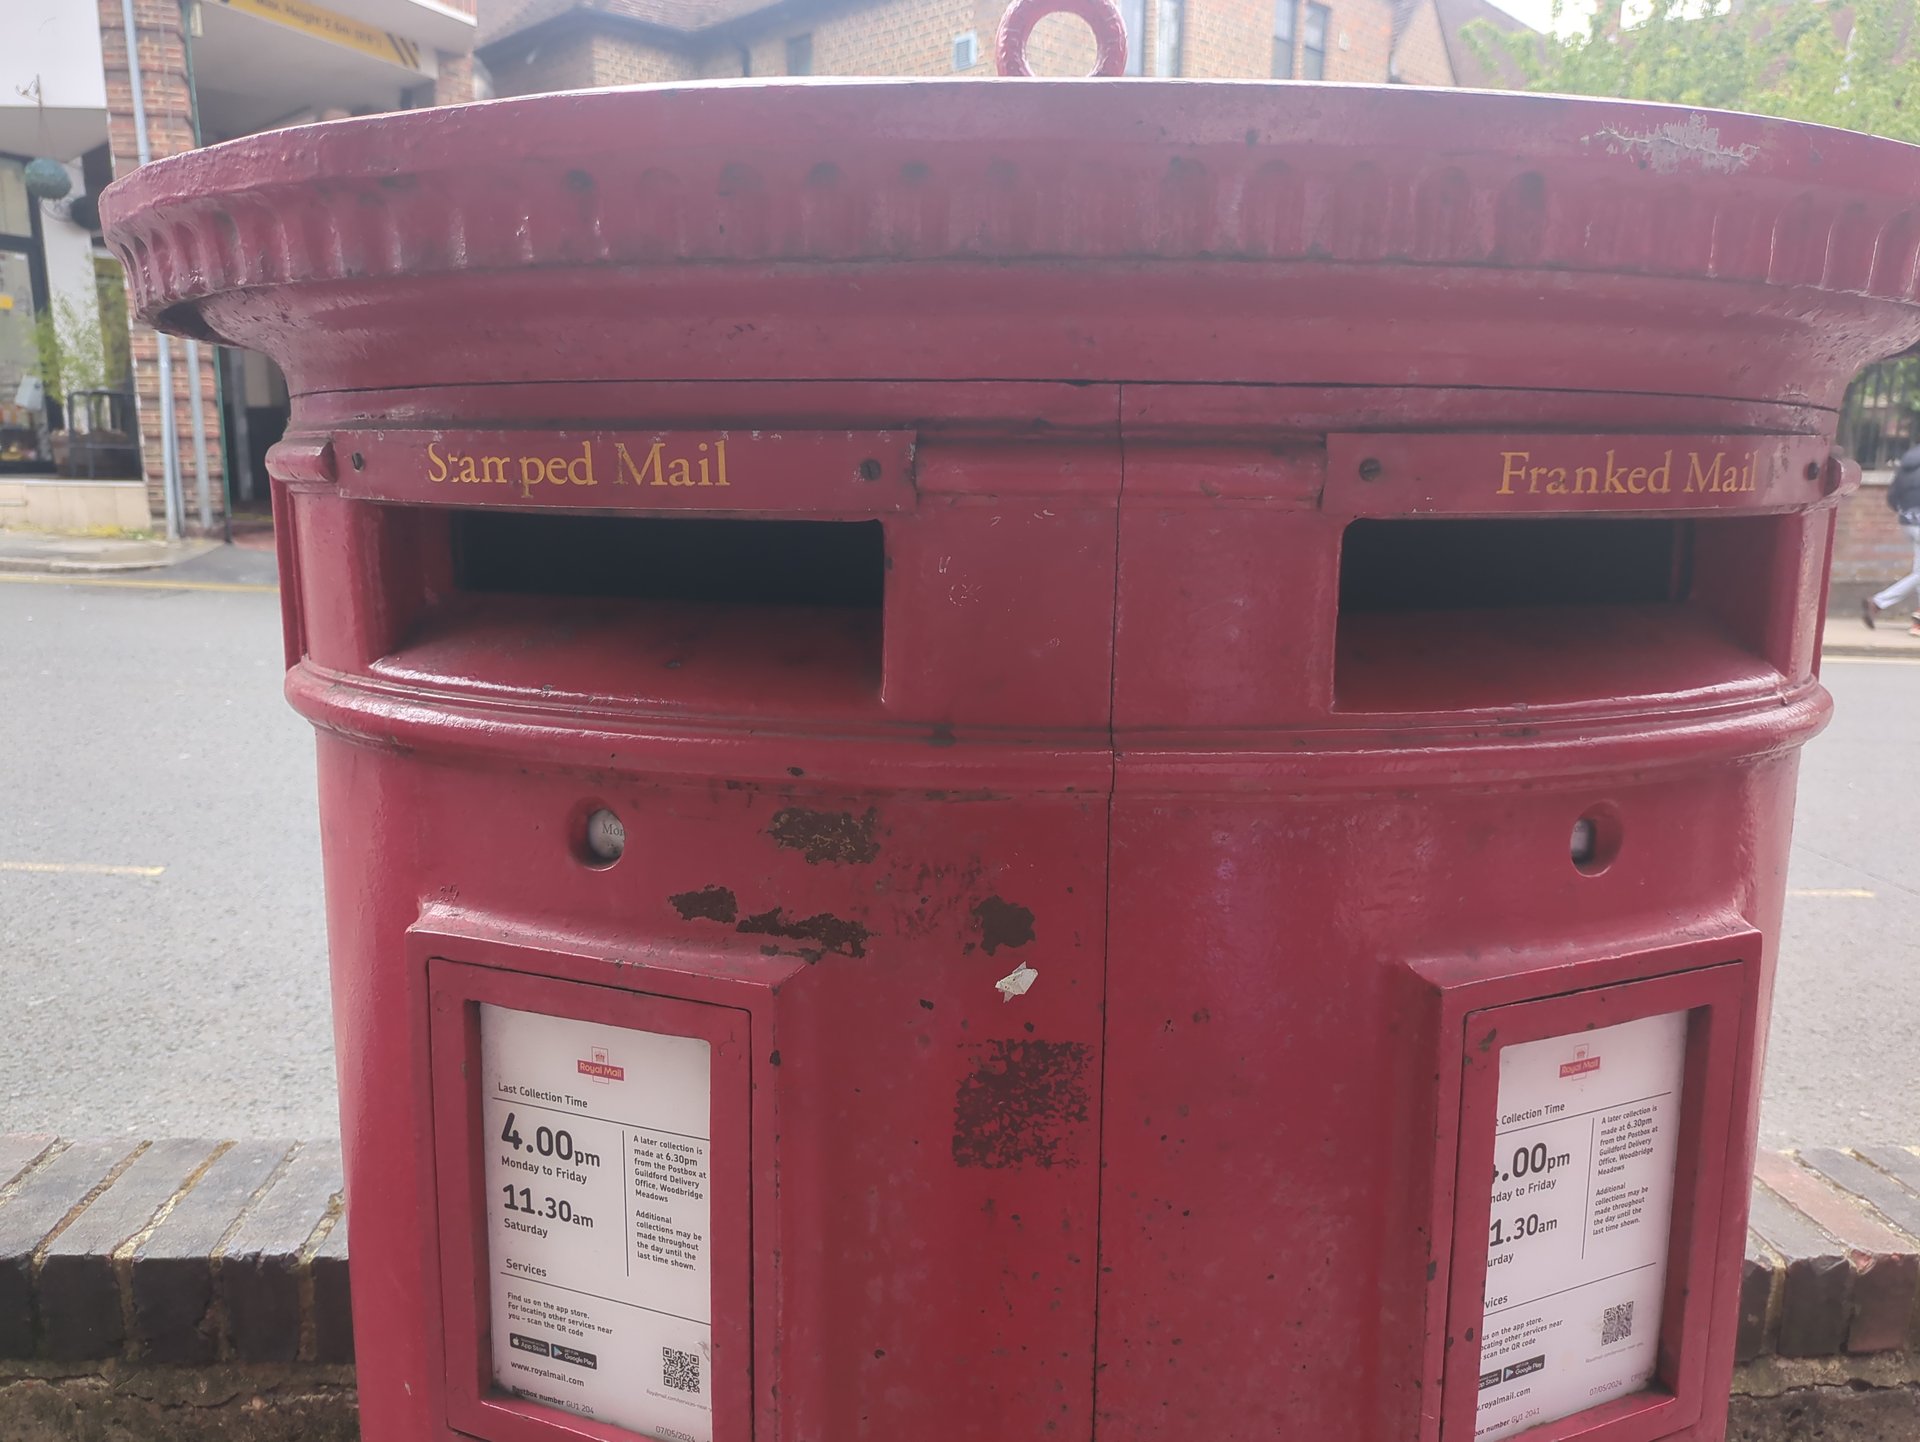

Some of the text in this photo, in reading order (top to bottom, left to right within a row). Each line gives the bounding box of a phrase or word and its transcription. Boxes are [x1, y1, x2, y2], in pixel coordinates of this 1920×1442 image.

[614, 440, 730, 486] Mail
[1496, 449, 1759, 494] Franked Mail
[579, 1062, 621, 1077] Royal Mail
[1561, 1059, 1598, 1074] Royal Mail
[498, 1081, 587, 1108] Last Collection Time
[1501, 1109, 1542, 1125] Collection
[1544, 1103, 1565, 1114] Time
[1607, 1114, 1621, 1122] later
[1623, 1107, 1650, 1119] collection
[1600, 1127, 1617, 1135] made
[1626, 1117, 1652, 1129] 6.30pm
[500, 1112, 600, 1167] 4.00pm
[640, 1136, 657, 1146] later
[659, 1141, 694, 1153] collection
[696, 1147, 702, 1155] is
[1599, 1138, 1651, 1156] Guildford Delivery
[1600, 1138, 1614, 1146] from
[1627, 1129, 1650, 1138] Postbox
[634, 1148, 653, 1157] made
[665, 1152, 697, 1166] 6.30pm
[1598, 1147, 1653, 1166] Office, Woodbridge
[501, 1155, 587, 1185] Monday to Friday
[634, 1157, 651, 1167] from
[653, 1162, 665, 1170] the
[668, 1164, 696, 1177] Postbox
[1598, 1164, 1624, 1176] Meadows
[634, 1168, 699, 1189] Guildford Delivery
[1515, 1187, 1524, 1196] to
[1528, 1179, 1556, 1193] Friday
[635, 1178, 703, 1200] Office, Woodbridge
[635, 1189, 668, 1202] Meadows
[1595, 1182, 1625, 1196] Additional
[1595, 1193, 1626, 1206] collections
[1627, 1189, 1640, 1197] may
[502, 1183, 593, 1227] 11.30am
[1594, 1196, 1645, 1216] made throughout
[1617, 1209, 1630, 1219] until
[635, 1209, 671, 1224] Additional
[504, 1217, 547, 1239] Saturday
[636, 1221, 702, 1241] collections may be
[1593, 1218, 1640, 1235] last time shown.
[636, 1231, 698, 1251] made throughout
[636, 1241, 696, 1260] the day until the
[506, 1258, 546, 1277] Services
[637, 1251, 696, 1271] last time shown.
[507, 1291, 521, 1301] Find
[543, 1301, 554, 1310] the
[556, 1305, 568, 1314] app
[570, 1309, 589, 1319] store.
[508, 1301, 612, 1334] For locating other services near
[508, 1312, 520, 1320] you
[527, 1317, 542, 1325] scan
[543, 1321, 554, 1329] the
[556, 1323, 566, 1332] QR
[568, 1328, 583, 1337] code
[1512, 1322, 1524, 1331] app
[1526, 1317, 1543, 1327] store.
[1504, 1333, 1521, 1343] other
[1522, 1325, 1547, 1337] services
[1549, 1319, 1563, 1328] near
[532, 1344, 546, 1353] Store
[1483, 1351, 1497, 1360] scan
[1511, 1341, 1520, 1350] QR
[1521, 1338, 1536, 1347] code
[564, 1353, 594, 1367] Google Play
[510, 1361, 584, 1386] www.royalmail.com
[1515, 1365, 1532, 1375] Google
[511, 1385, 537, 1398] Postbox
[538, 1394, 564, 1405] number
[565, 1400, 579, 1411] GU1
[1486, 1419, 1510, 1432] number
[1511, 1413, 1523, 1423] GU1
[655, 1425, 696, 1442] 07/05/2024
